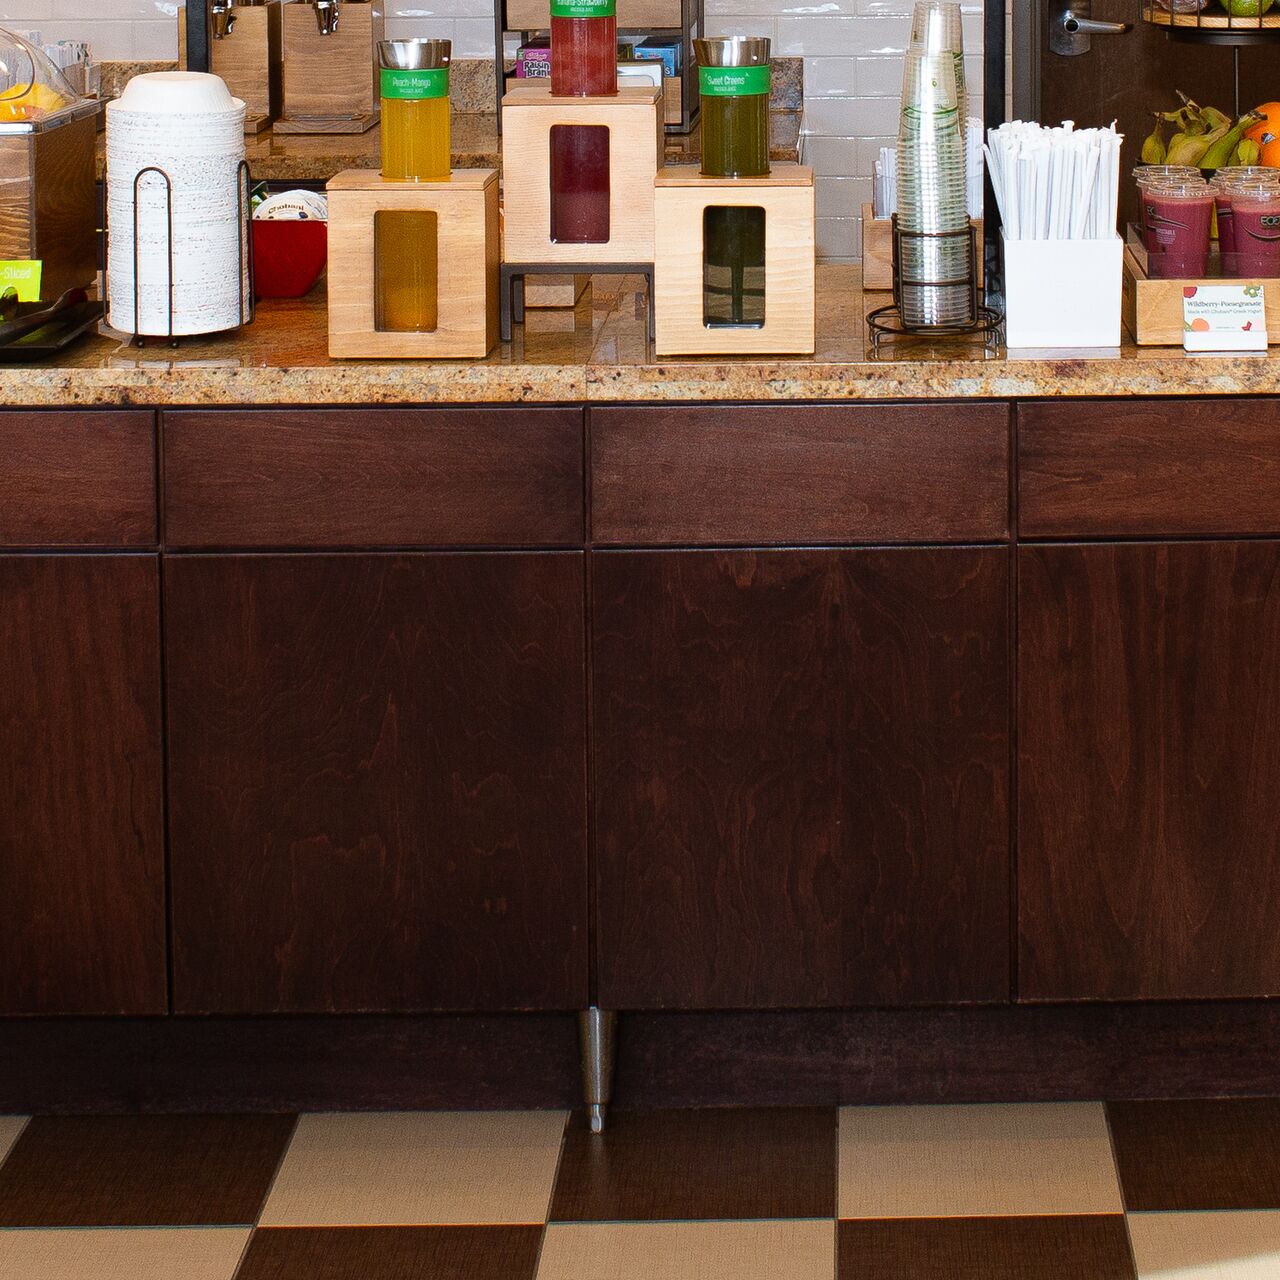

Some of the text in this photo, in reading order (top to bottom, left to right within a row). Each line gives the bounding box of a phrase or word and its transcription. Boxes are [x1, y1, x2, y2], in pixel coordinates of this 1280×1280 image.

[523, 61, 550, 71] Raisin
[527, 69, 547, 77] Bran
[707, 75, 723, 85] Sweet
